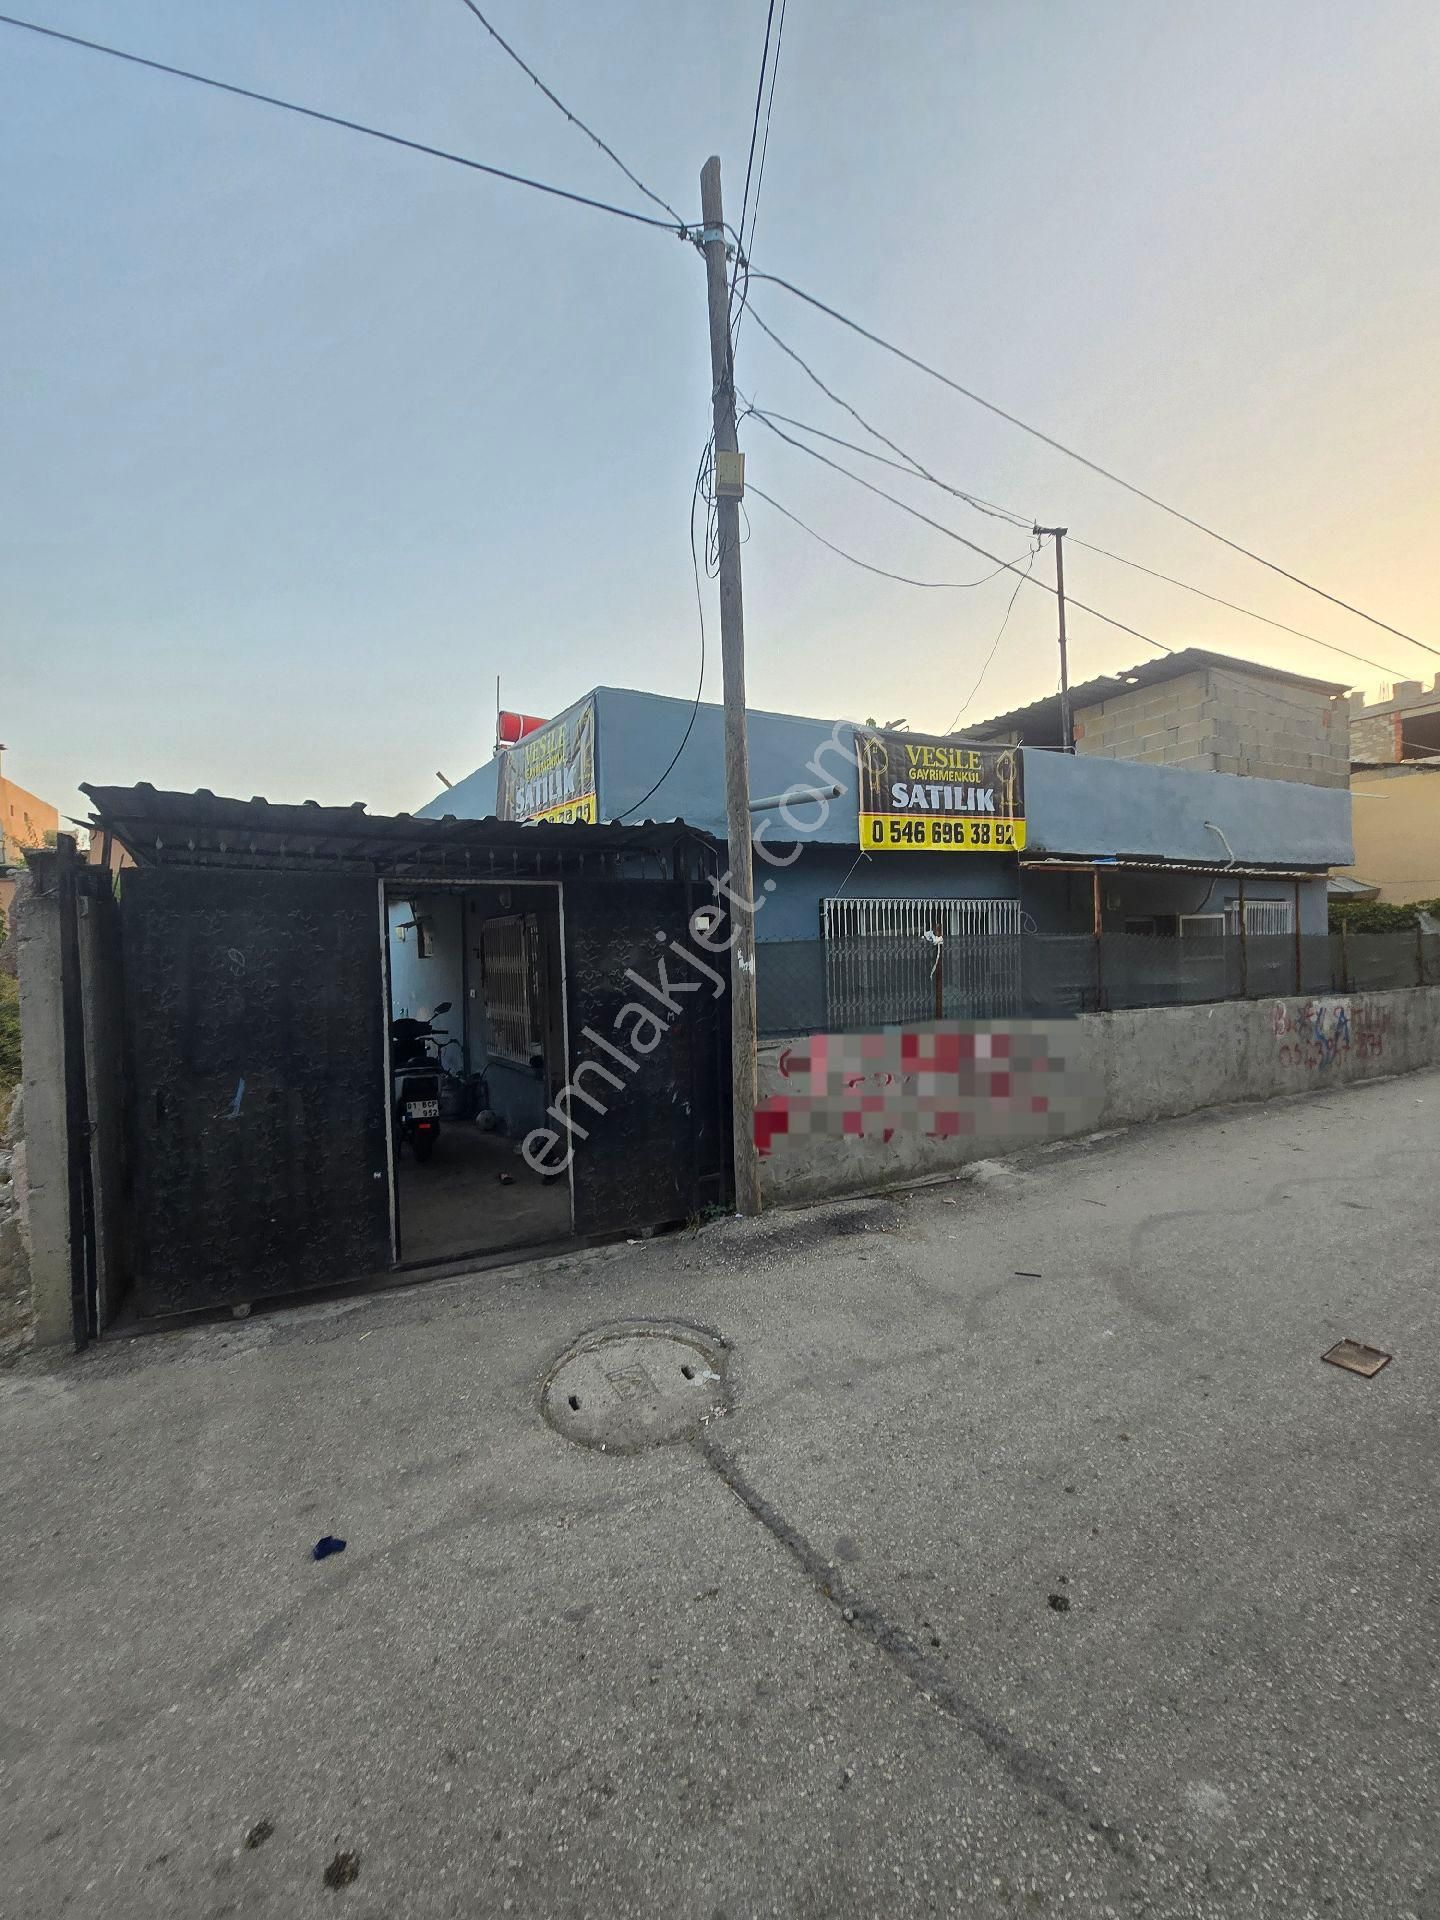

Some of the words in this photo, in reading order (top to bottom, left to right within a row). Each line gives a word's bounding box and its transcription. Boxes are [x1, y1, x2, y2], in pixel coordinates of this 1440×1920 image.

[516, 765, 575, 816] SATILIK
[891, 782, 995, 812] SATILIK
[872, 820, 884, 843] 0
[890, 821, 925, 844] 546
[931, 822, 965, 845] 696
[970, 823, 991, 845] 38
[995, 824, 1014, 845] 92
